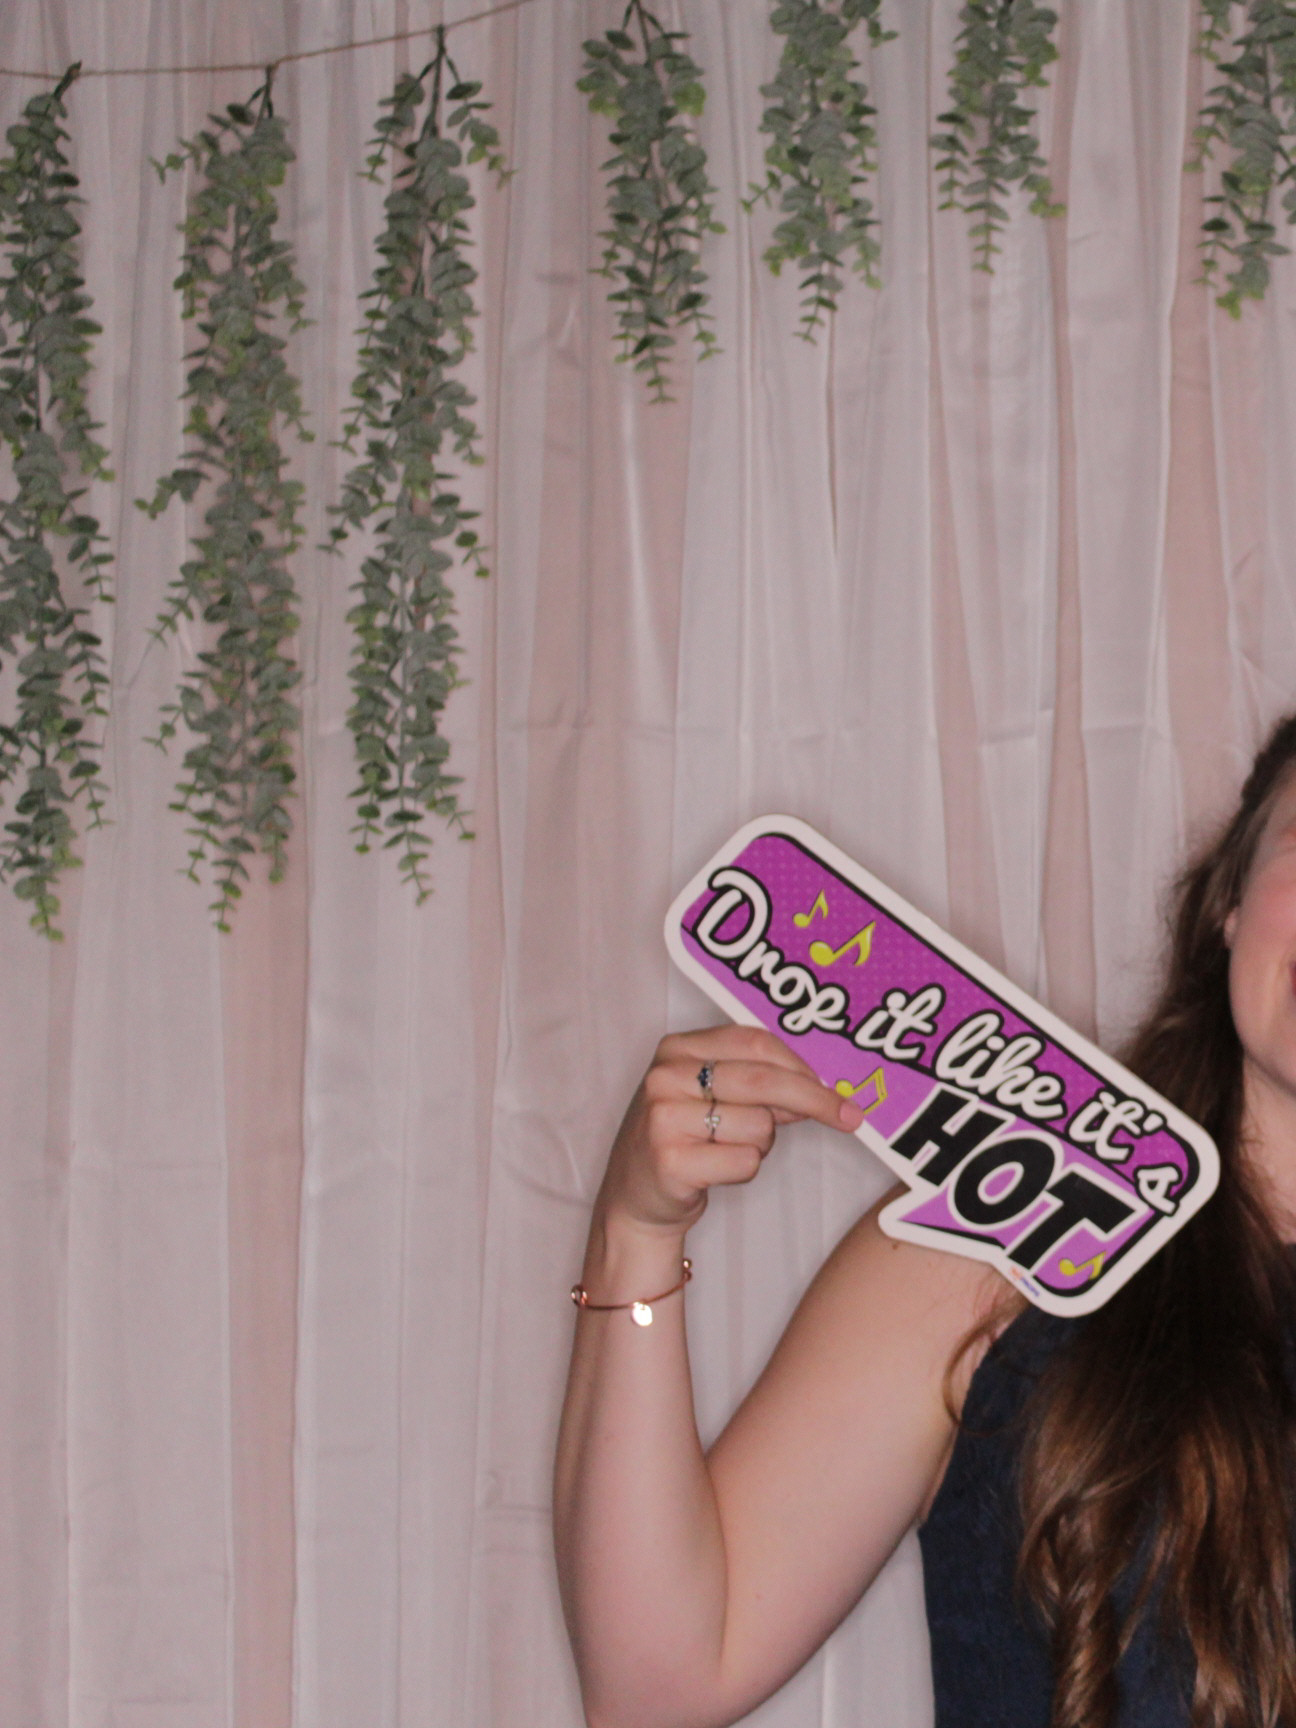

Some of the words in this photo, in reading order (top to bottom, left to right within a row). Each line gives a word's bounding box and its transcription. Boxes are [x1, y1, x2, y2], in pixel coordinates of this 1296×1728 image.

[696, 868, 848, 1032] Drop
[855, 985, 941, 1058] it
[935, 1012, 1066, 1120] like
[1067, 1092, 1180, 1214] it's
[890, 1087, 1139, 1270] HOT
